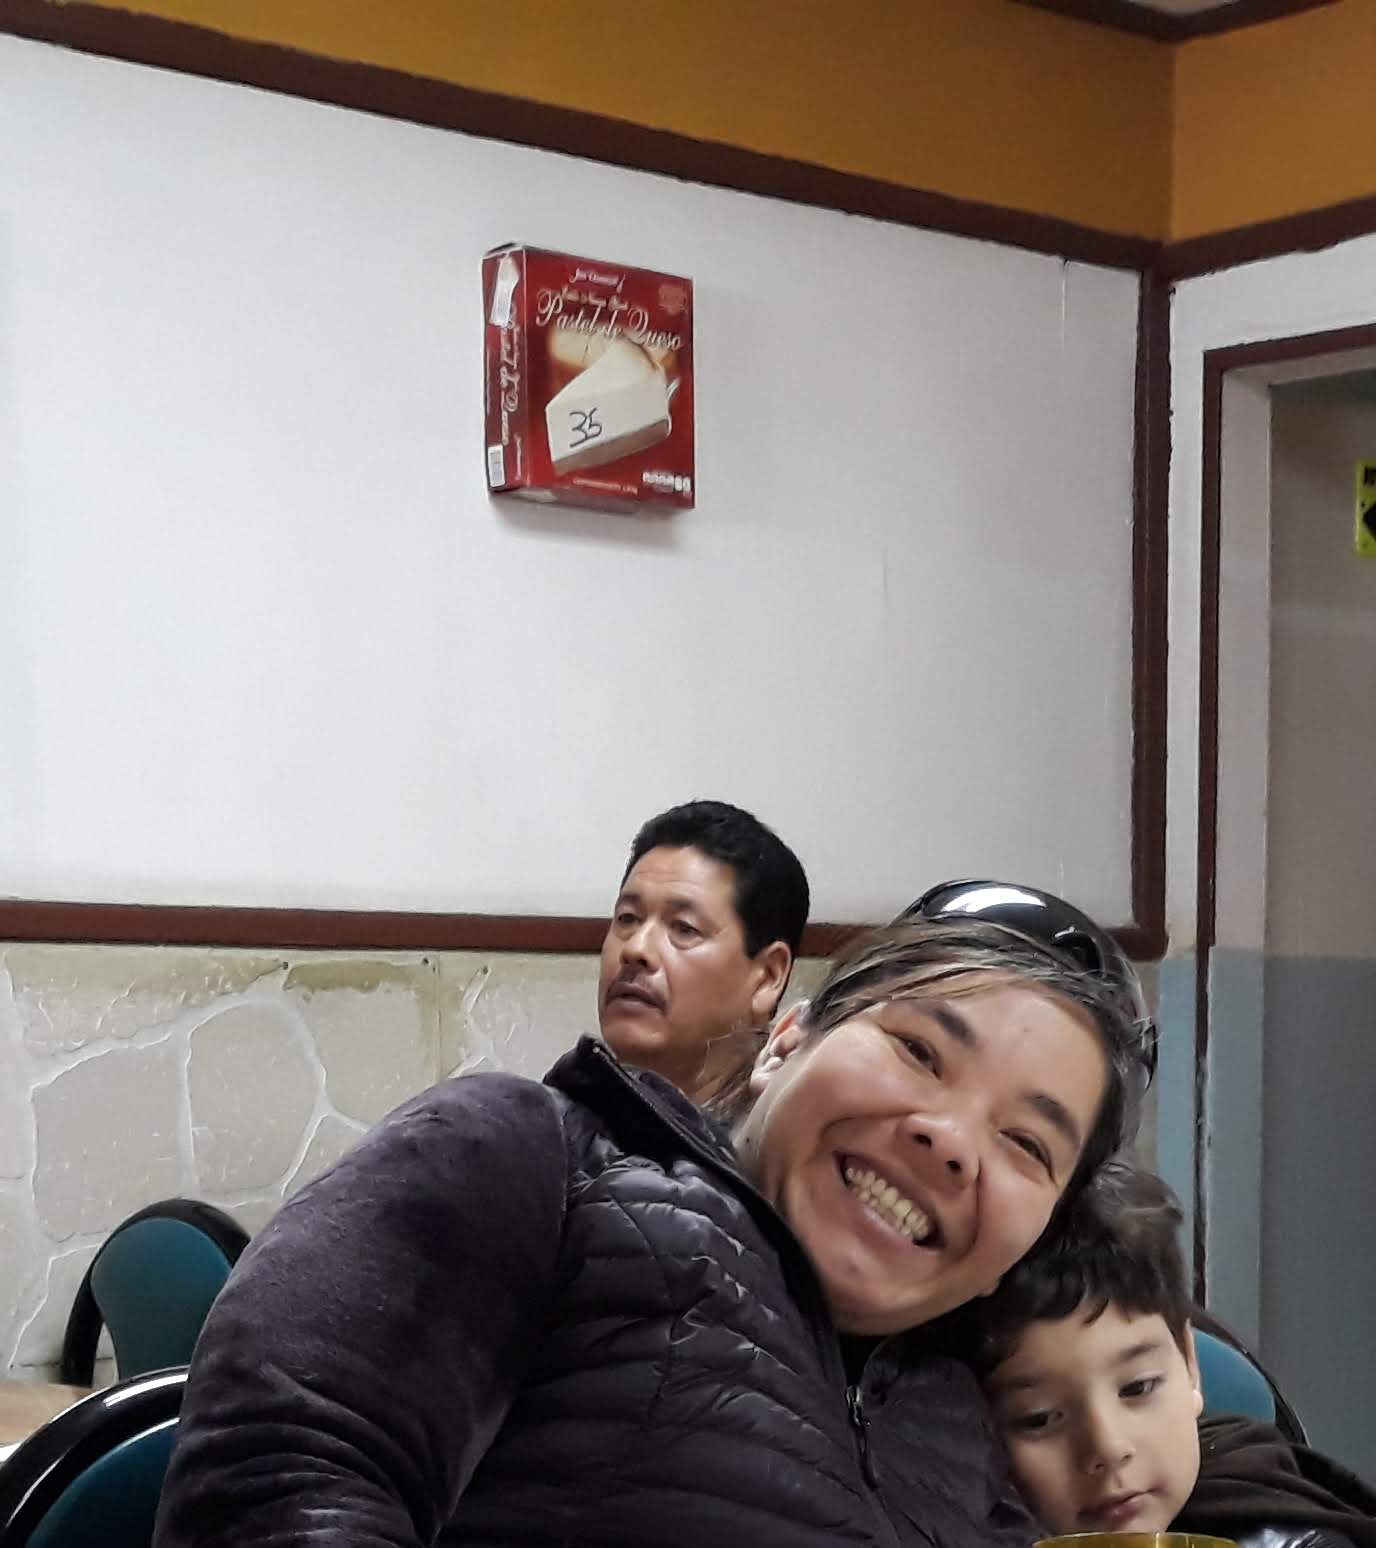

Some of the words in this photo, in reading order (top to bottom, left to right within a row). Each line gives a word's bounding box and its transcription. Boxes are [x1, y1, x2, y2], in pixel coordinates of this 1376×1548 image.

[536, 287, 601, 334] Pastel
[627, 305, 683, 349] Queso
[569, 408, 603, 449] 35
